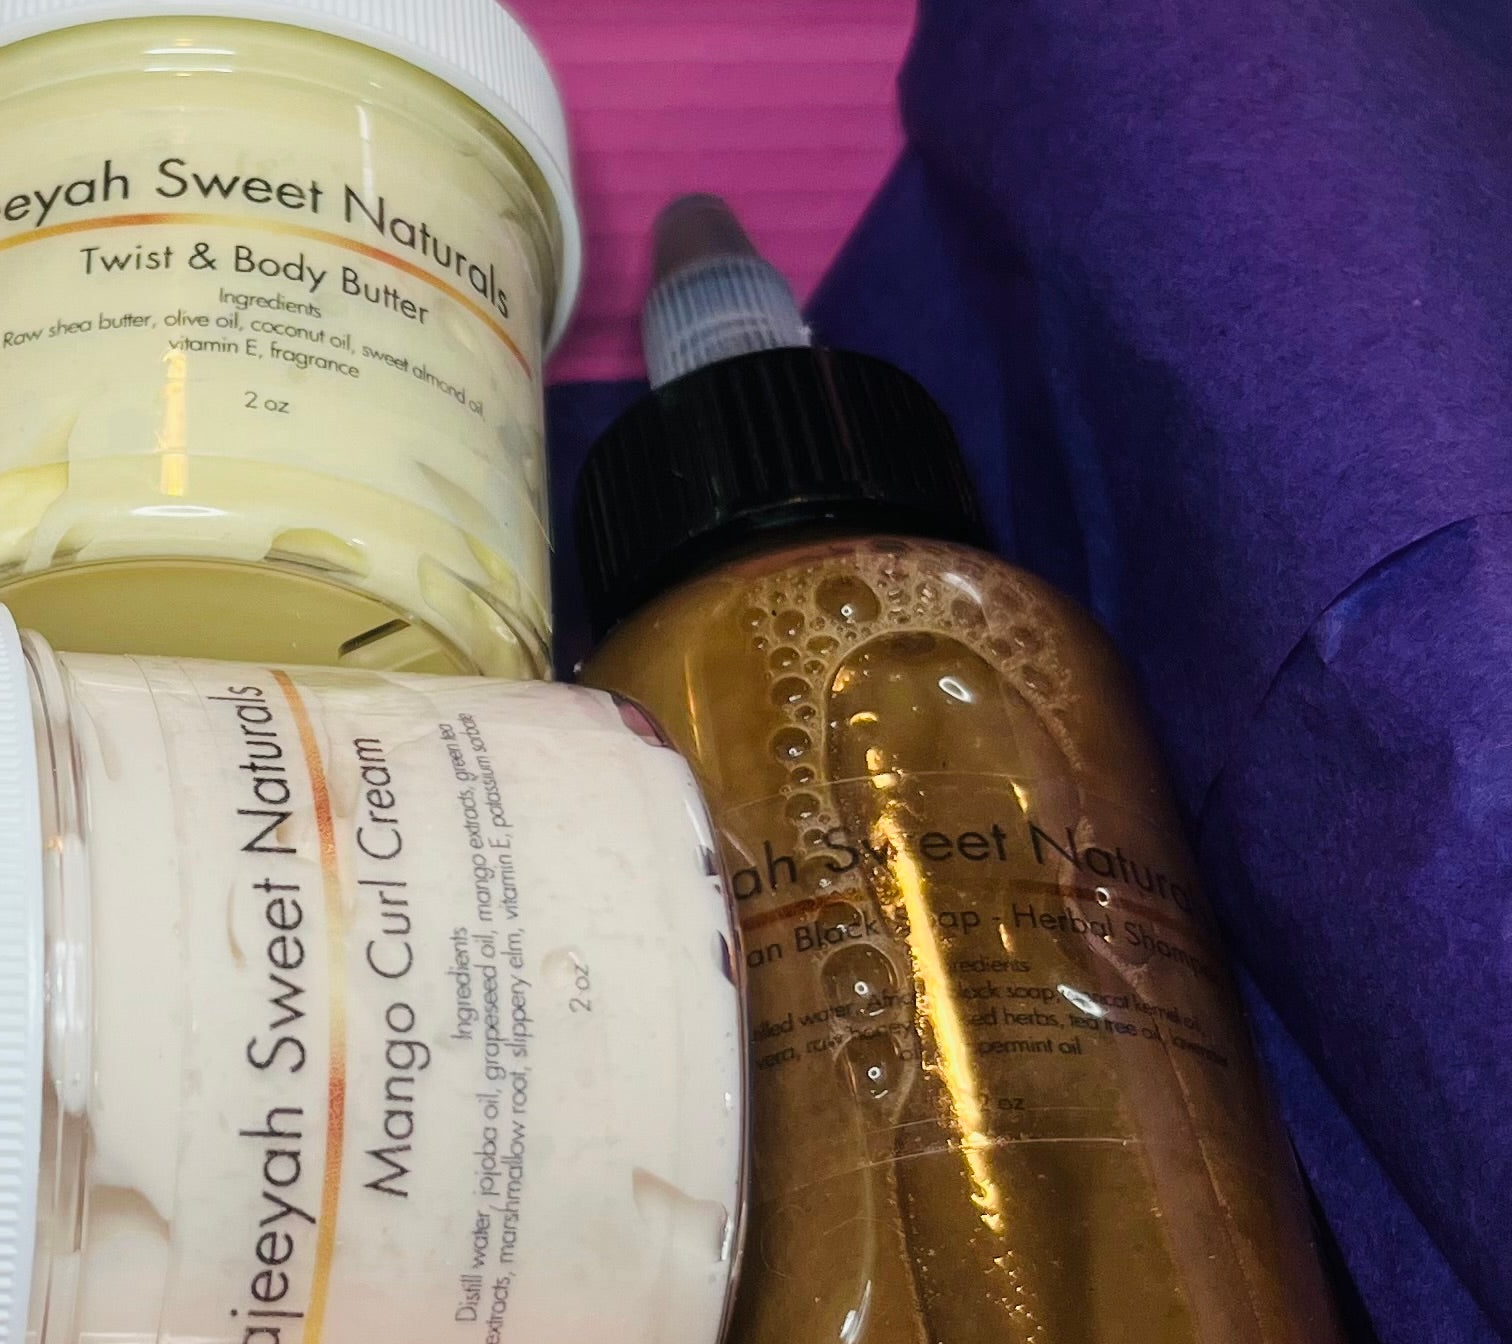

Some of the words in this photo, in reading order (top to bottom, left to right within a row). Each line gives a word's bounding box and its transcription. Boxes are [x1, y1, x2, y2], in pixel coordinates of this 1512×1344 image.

[155, 157, 324, 214] Sweet
[343, 183, 509, 319] Naturals
[80, 245, 175, 274] Twist
[187, 242, 217, 271] &
[234, 244, 327, 294] Body
[341, 265, 430, 325] Butter
[219, 287, 323, 319] Ingredients
[2, 329, 45, 349] Raw
[48, 317, 93, 339] shea
[98, 311, 157, 331] butter,
[164, 309, 211, 328] olive
[216, 312, 244, 332] oil,
[251, 319, 326, 344] coconut
[329, 333, 355, 355] oil,
[362, 344, 409, 372] sweet
[412, 364, 466, 406] almond
[168, 336, 239, 355] vitamin
[270, 340, 361, 379] fragrance
[243, 391, 259, 409] 2
[264, 399, 290, 414] oz
[206, 684, 297, 854] Naturals
[352, 736, 403, 860] Cream
[477, 756, 514, 828] potassium
[472, 853, 496, 922] mango
[499, 854, 519, 921] vitamin
[357, 879, 414, 979] Curl
[472, 930, 499, 959] oil,
[500, 927, 525, 970] elm,
[793, 918, 879, 953] Black
[1011, 903, 1114, 939] Herbal
[246, 877, 307, 1073] Sweet
[445, 926, 479, 1040] Ingredients
[568, 996, 592, 1013] 2
[574, 963, 590, 991] oz
[474, 964, 510, 1082] grapeseed
[504, 973, 534, 1058] slippery
[363, 1002, 431, 1199] Mango
[475, 1088, 502, 1121] oil,
[473, 1126, 502, 1196] jojoba
[498, 1120, 525, 1266] marshmallow
